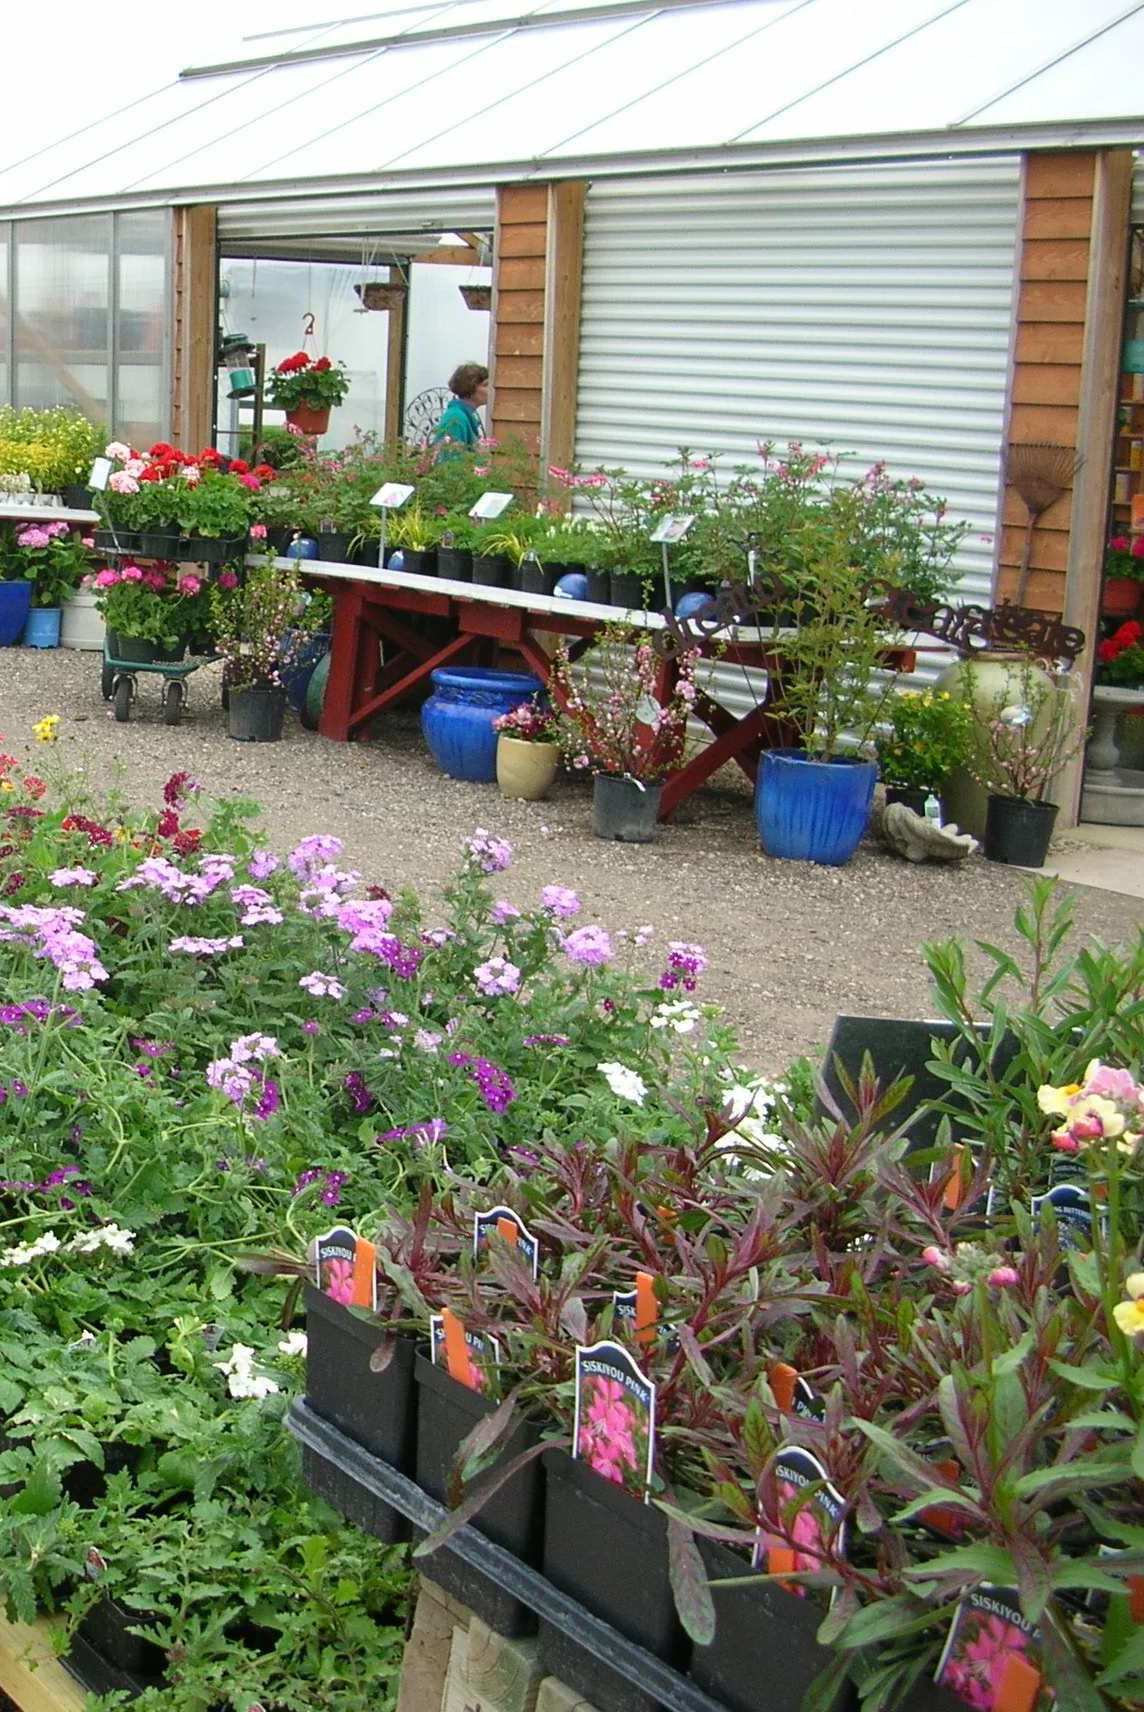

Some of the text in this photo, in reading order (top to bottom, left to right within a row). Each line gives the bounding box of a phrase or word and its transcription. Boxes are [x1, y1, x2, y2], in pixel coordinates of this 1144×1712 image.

[320, 1245, 353, 1260] SISKIYOU
[582, 1360, 649, 1403] SISKIYOU PINK
[970, 1593, 1030, 1631] SISKIYOU
